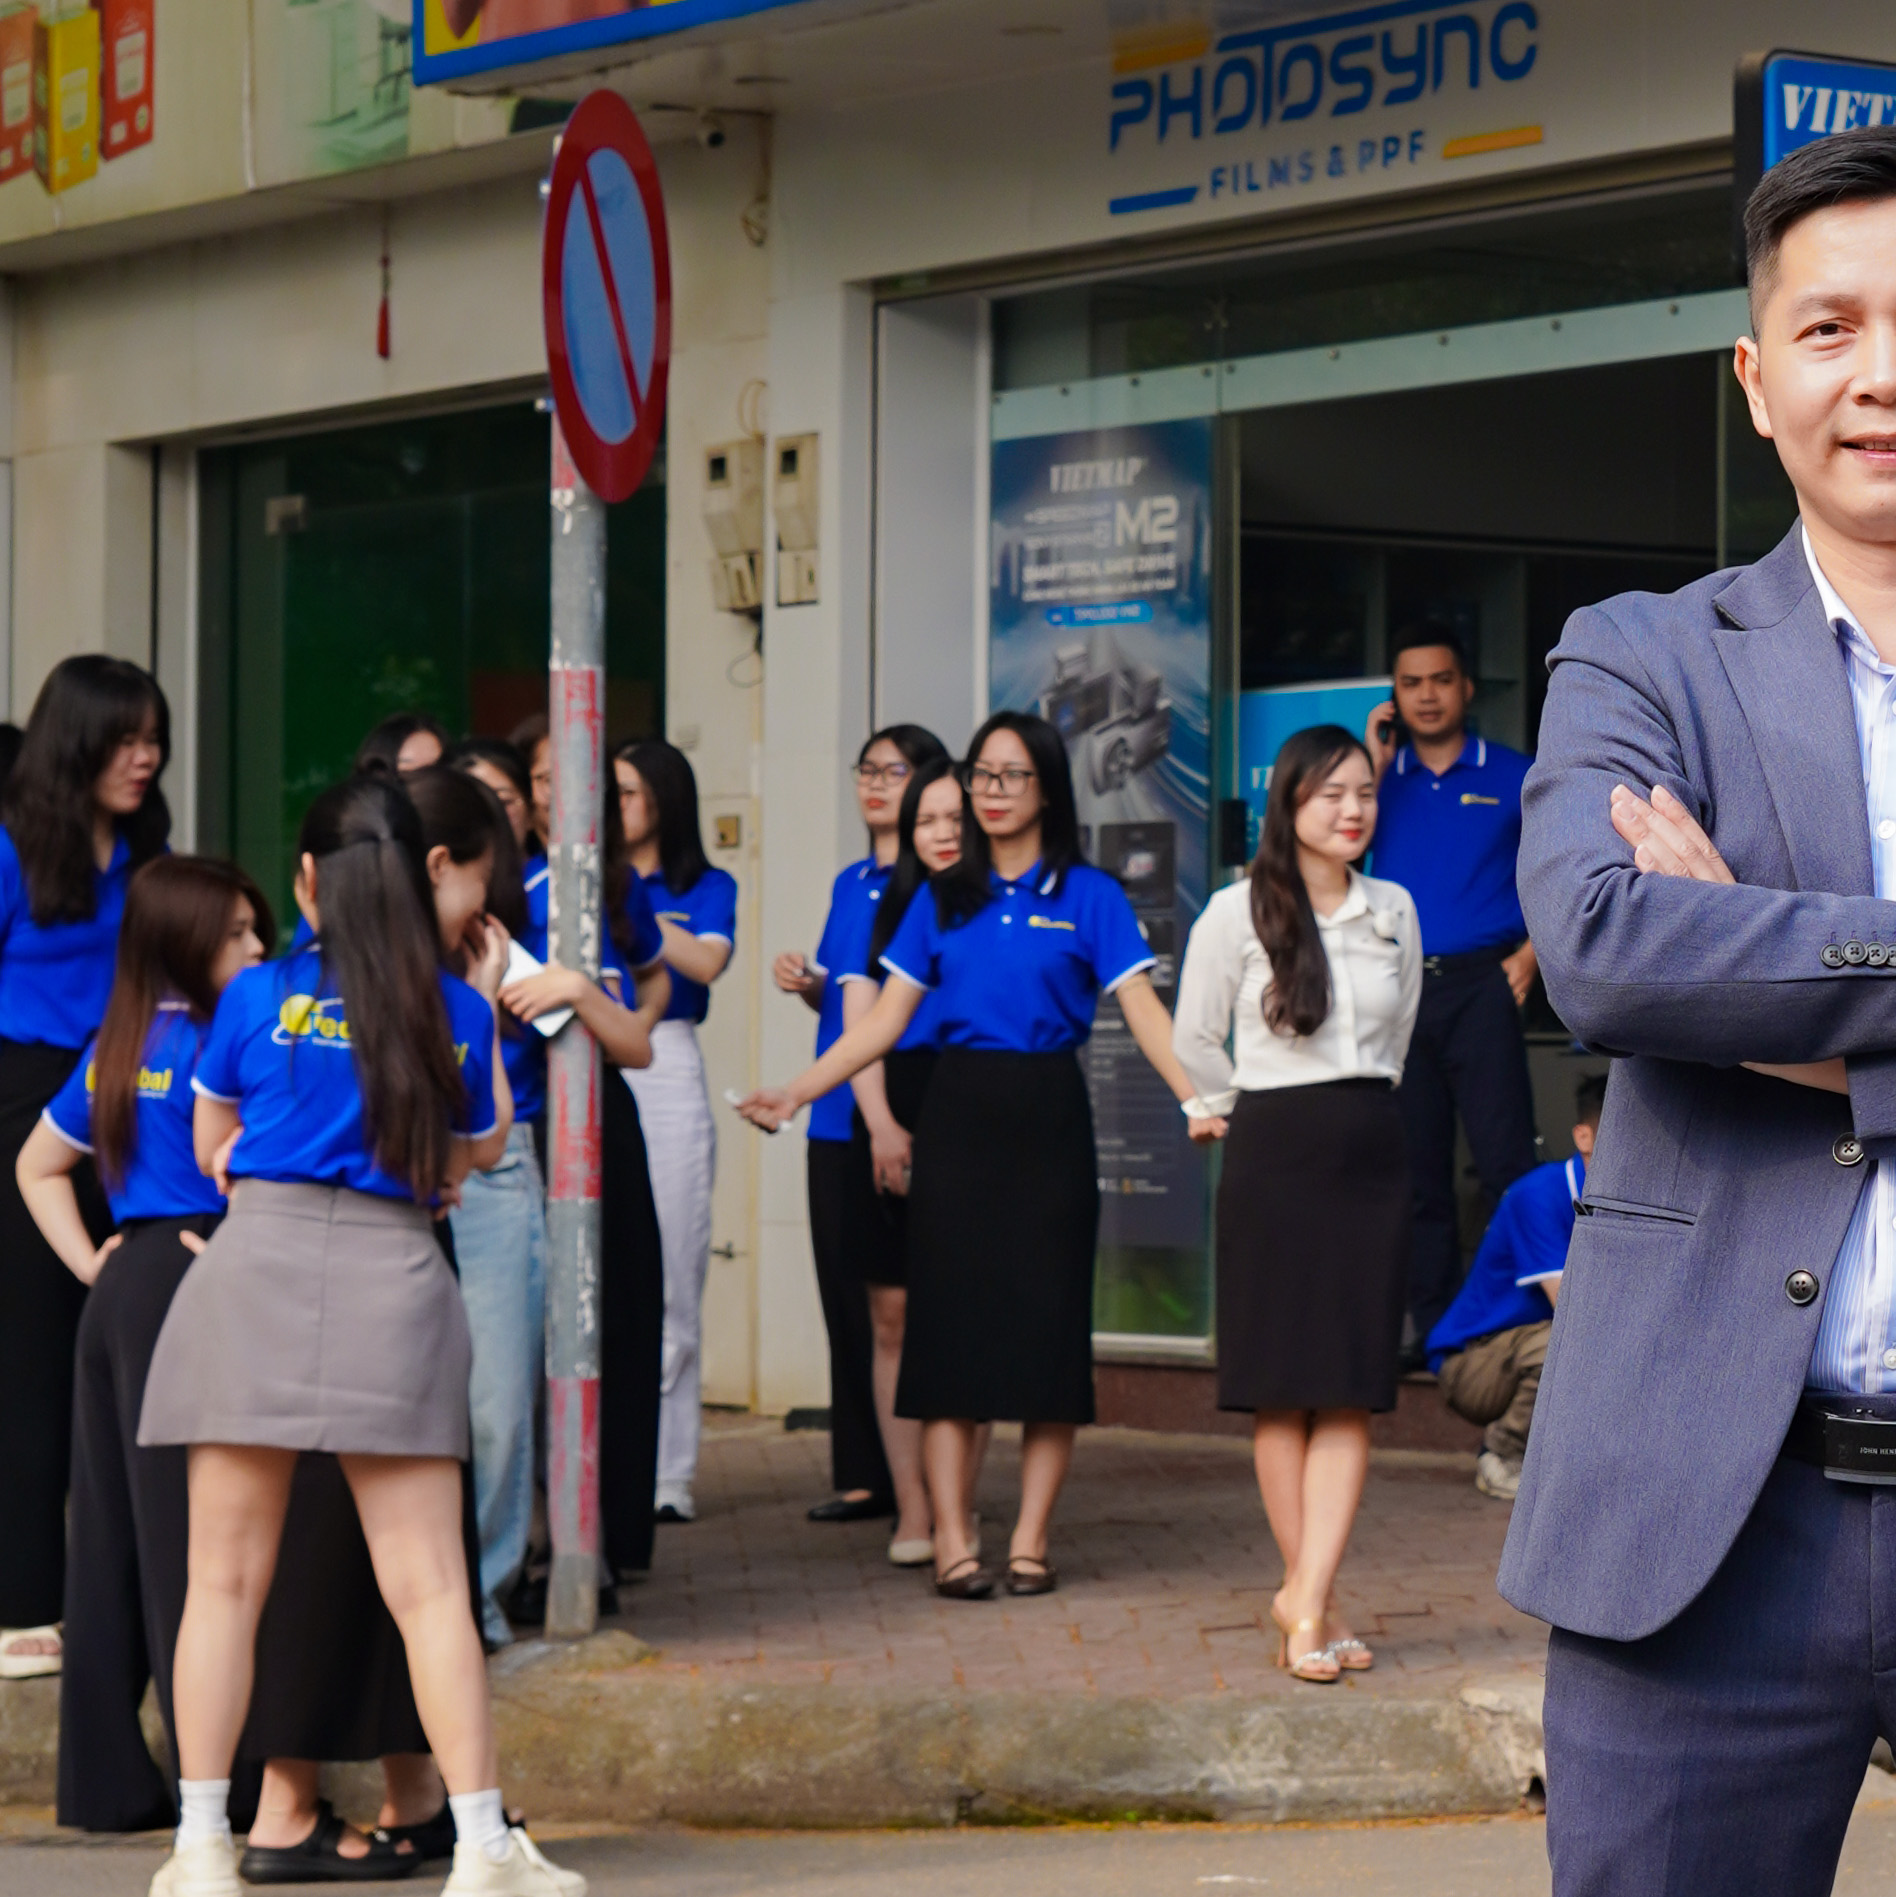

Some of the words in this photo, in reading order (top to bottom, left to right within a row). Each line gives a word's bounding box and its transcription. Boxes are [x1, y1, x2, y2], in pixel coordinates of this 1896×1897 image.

[1210, 151, 1313, 198] FILMS
[1327, 146, 1346, 179] &
[1358, 130, 1426, 172] PPF
[1114, 494, 1179, 546] M2
